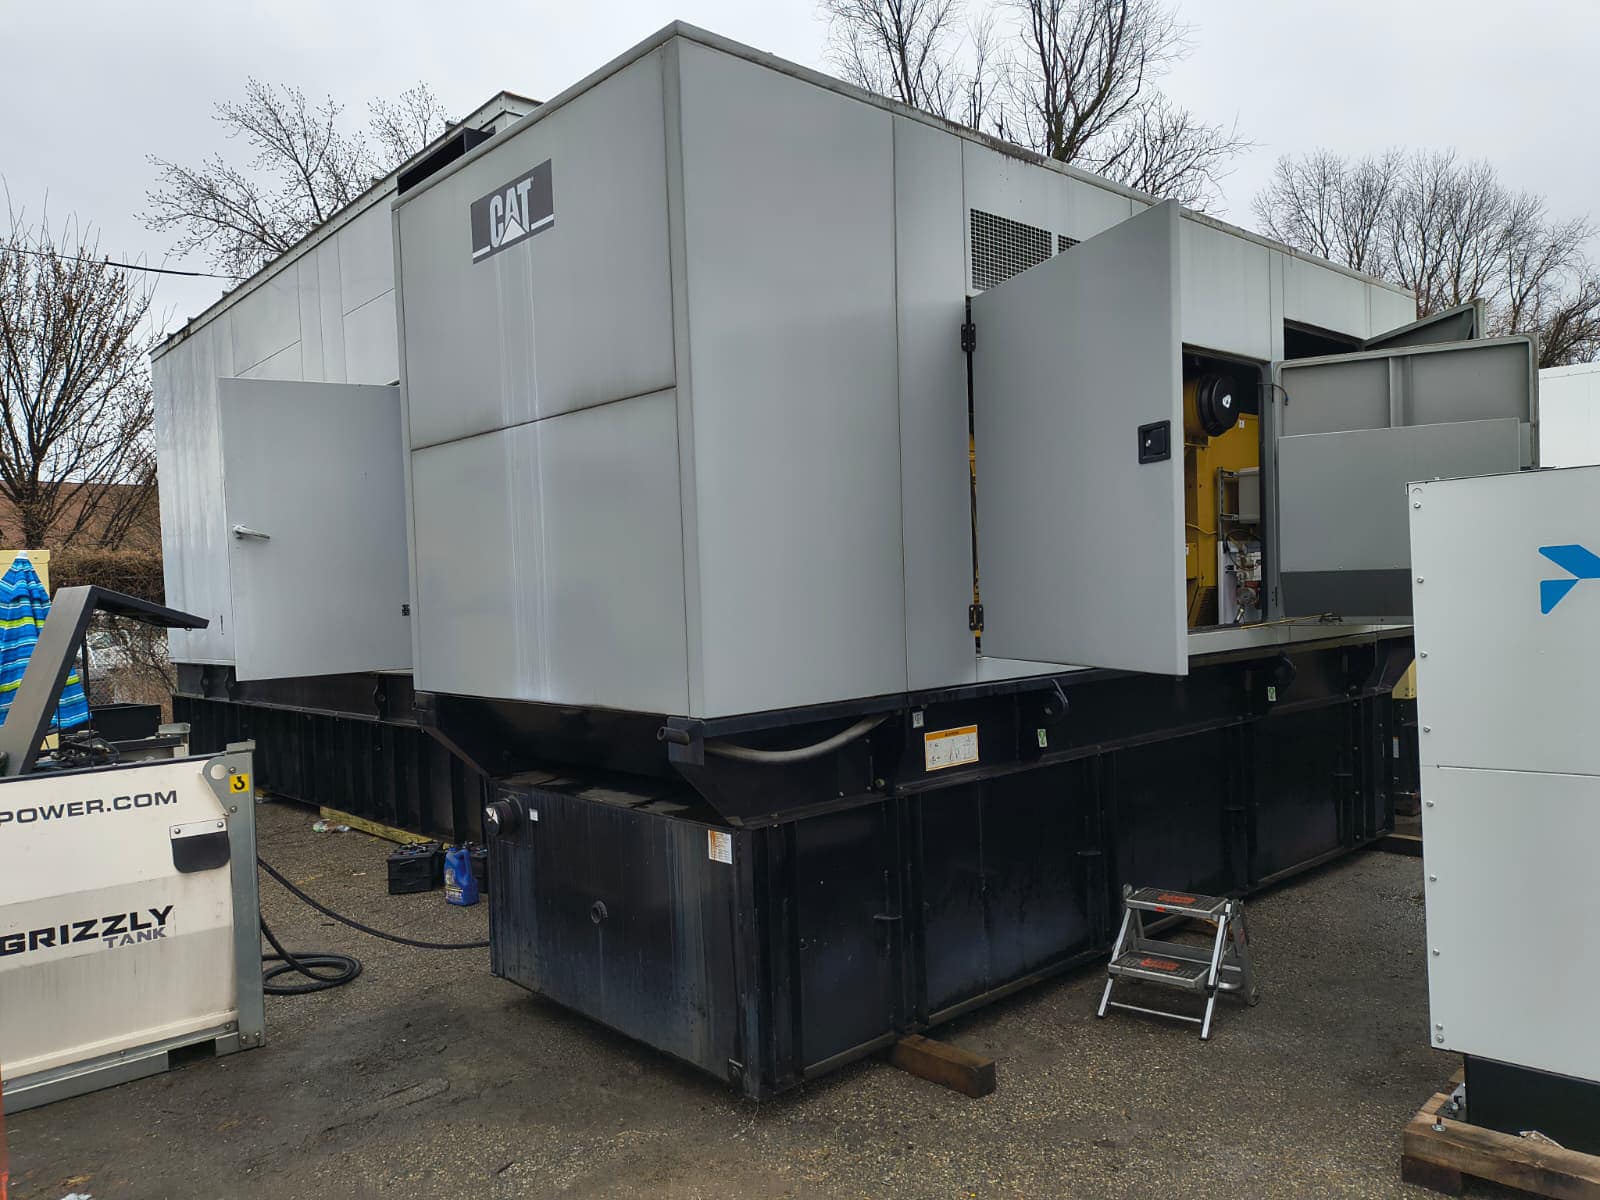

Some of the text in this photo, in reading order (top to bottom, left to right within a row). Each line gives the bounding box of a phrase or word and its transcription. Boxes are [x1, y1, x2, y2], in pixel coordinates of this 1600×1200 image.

[489, 178, 531, 248] CAT
[0, 790, 178, 824] POWER.COM
[0, 905, 174, 957] GRIZZLY
[102, 926, 168, 949] TANK
